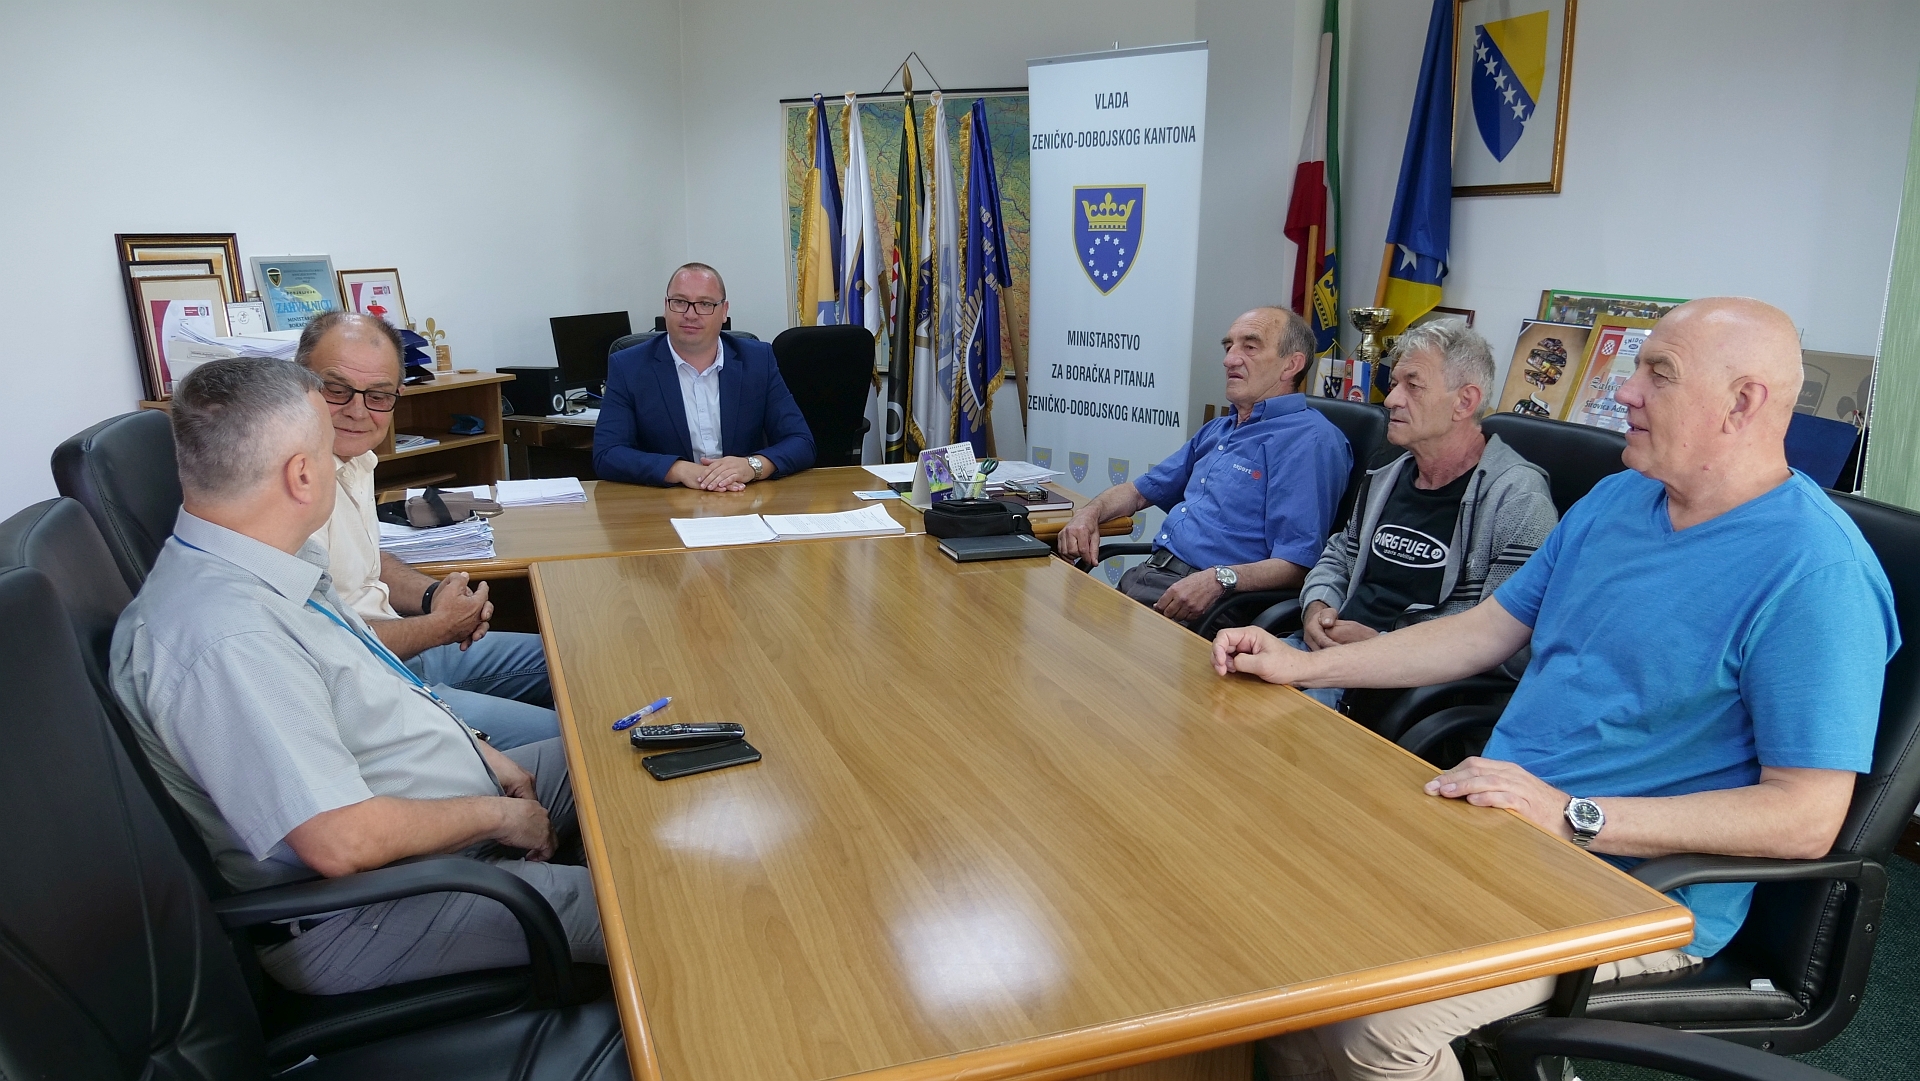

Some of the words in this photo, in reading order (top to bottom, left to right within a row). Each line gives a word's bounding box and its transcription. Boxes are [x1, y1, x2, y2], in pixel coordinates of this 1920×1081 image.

[1095, 91, 1129, 110] VLADA
[1032, 127, 1141, 150] ZENIČKO-DOBOJSKOG
[1144, 125, 1197, 144] KANTONA
[276, 300, 332, 314] ZAHVALNICU
[1067, 330, 1140, 350] MINISTARSTVO
[1051, 363, 1064, 380] ZA
[1066, 363, 1111, 385] BORAČKA
[1114, 368, 1155, 389] PITANJA
[1028, 394, 1128, 421] ZENIČKO-DOBOJSKOG
[1131, 406, 1180, 428] KANTONA
